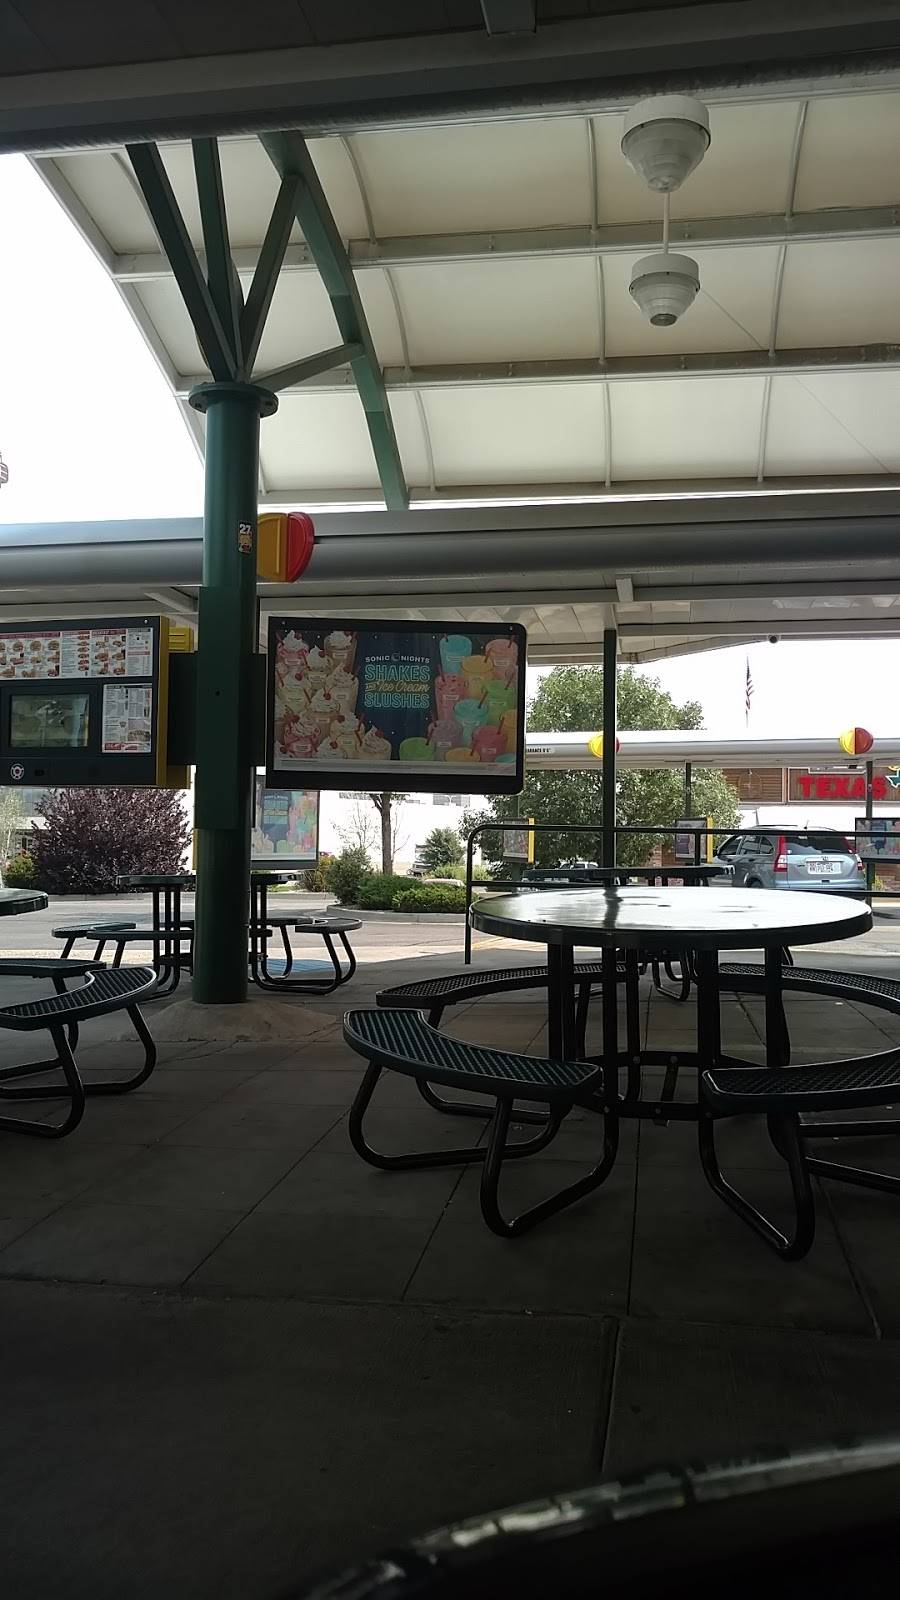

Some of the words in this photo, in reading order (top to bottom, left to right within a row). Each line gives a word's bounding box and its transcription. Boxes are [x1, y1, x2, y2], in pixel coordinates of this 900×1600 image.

[240, 523, 251, 534] 27
[365, 655, 390, 663] SONIC
[400, 655, 430, 664] NIGHTS
[364, 664, 430, 682] SHAKES
[395, 680, 430, 692] Cream
[364, 692, 430, 709] SLUSHES
[798, 775, 887, 799] TEXAS
